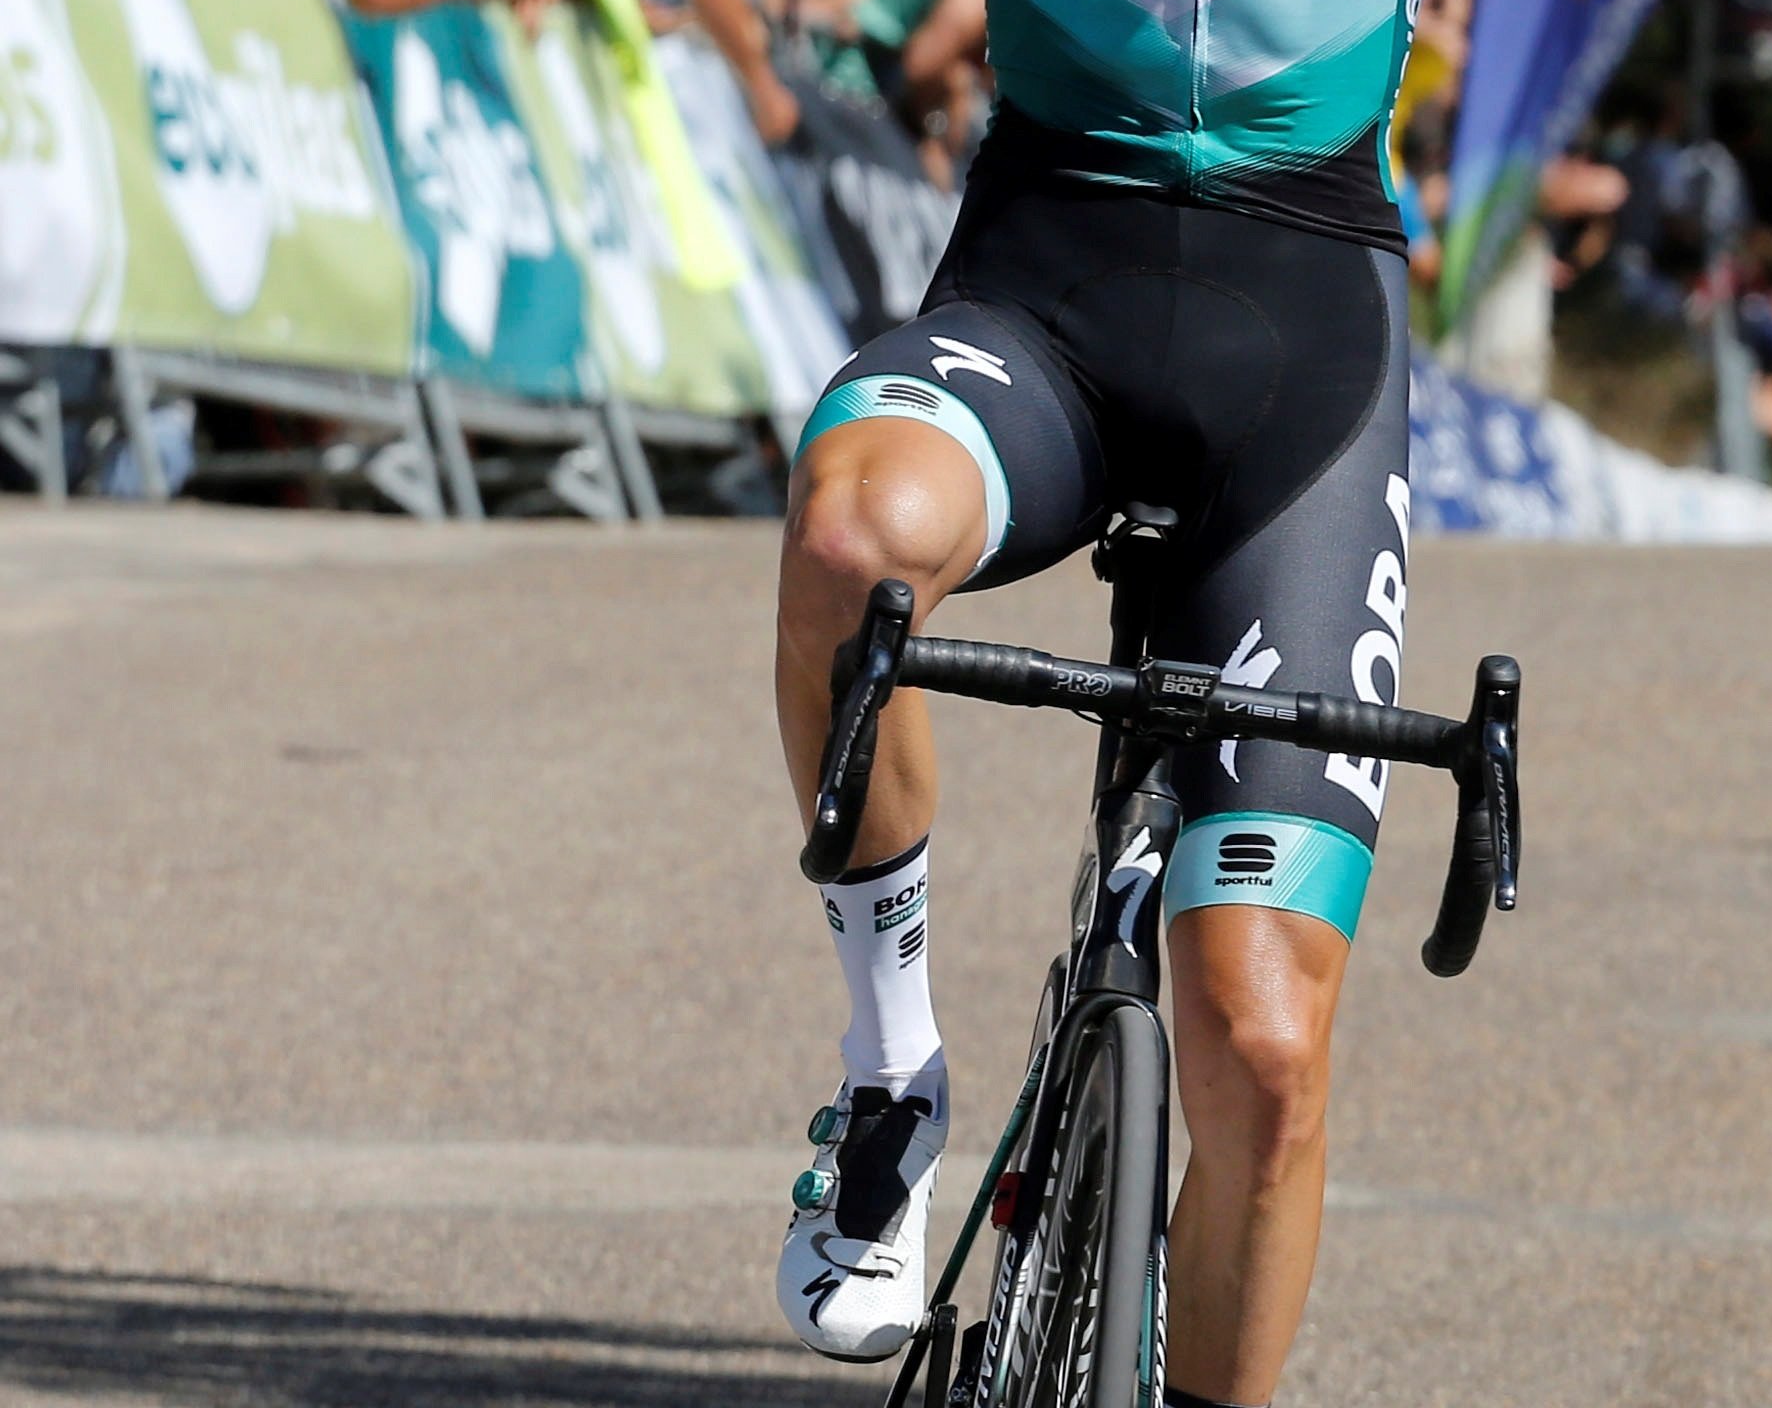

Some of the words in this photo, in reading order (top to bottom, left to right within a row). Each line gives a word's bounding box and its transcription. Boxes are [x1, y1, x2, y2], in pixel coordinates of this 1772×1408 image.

[1052, 667, 1113, 697] PRO
[1162, 682, 1211, 697] BOLT
[1225, 700, 1298, 721] VIBE
[1214, 875, 1273, 888] sportful
[873, 873, 927, 917] BOR
[972, 1235, 1019, 1408] SPECIAL
